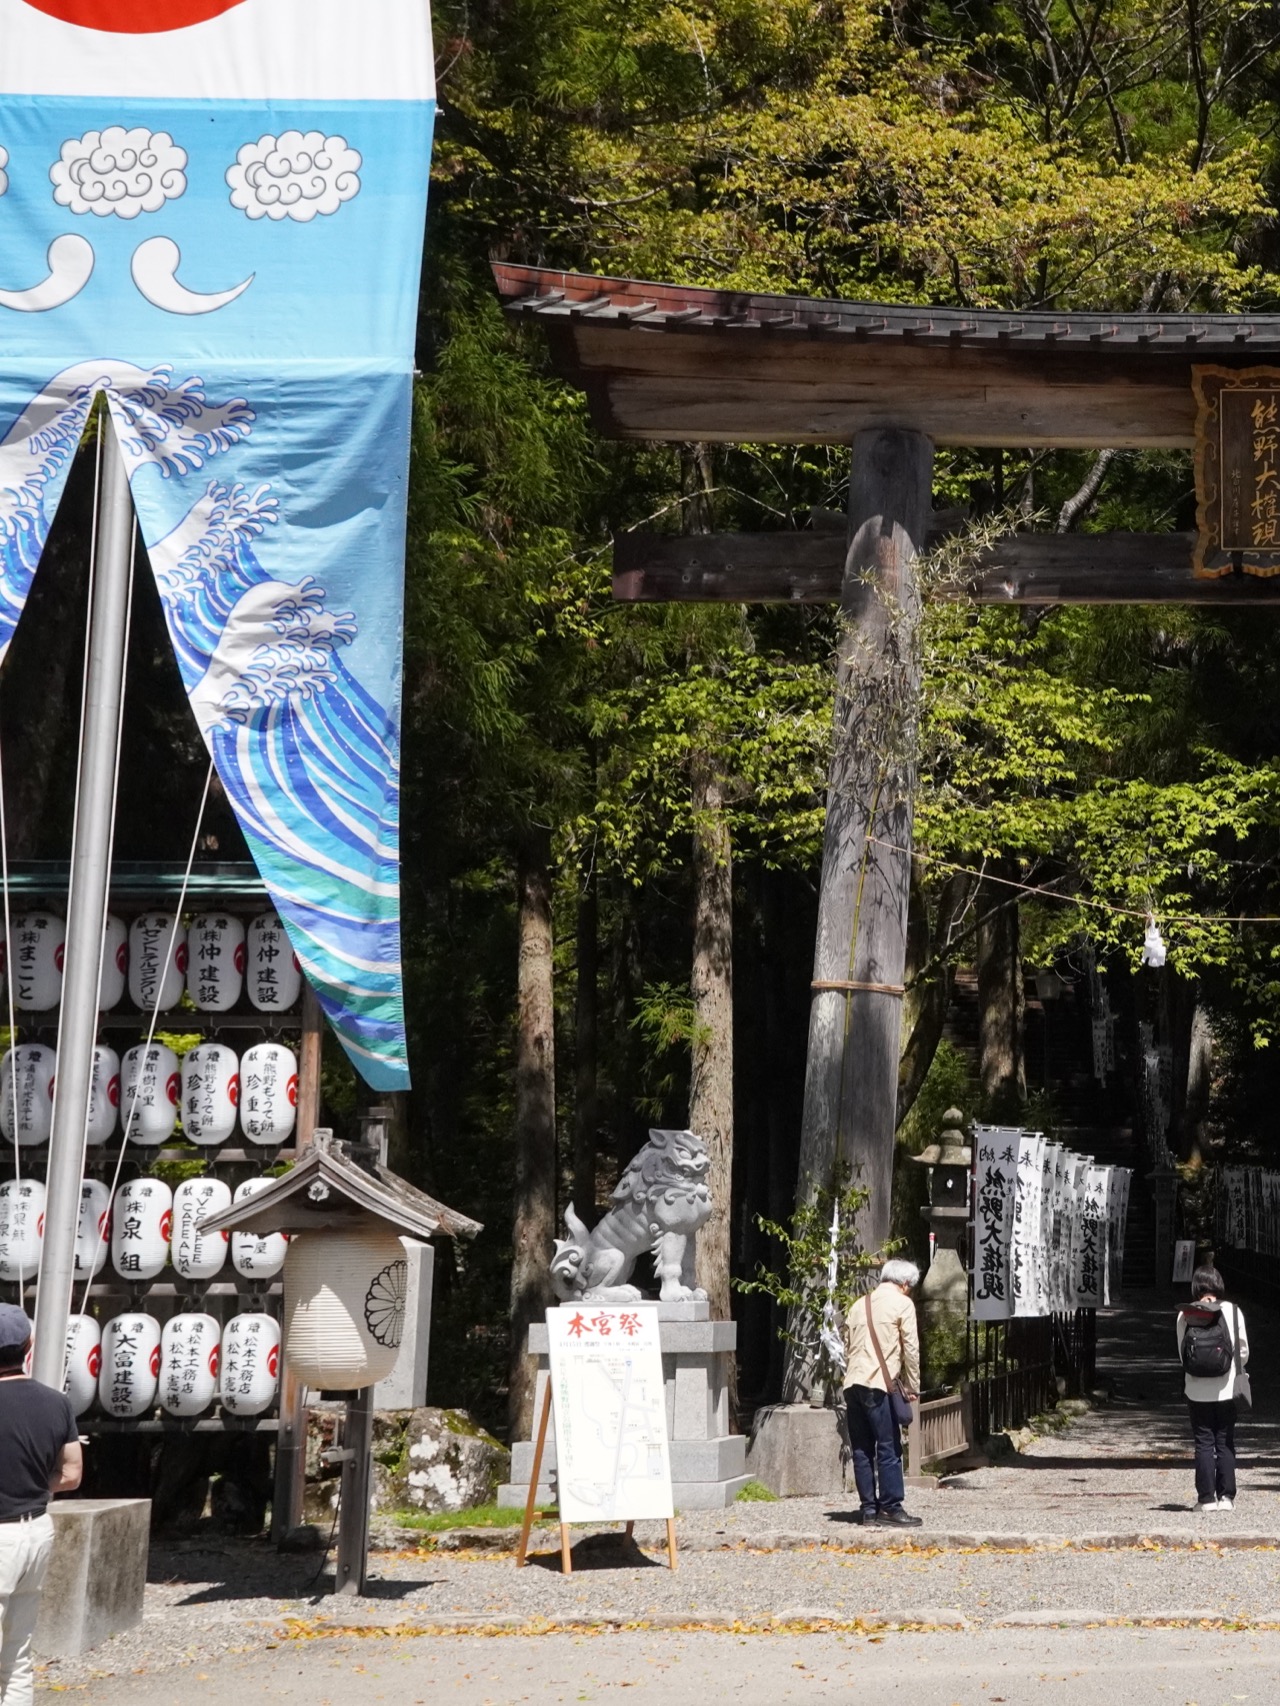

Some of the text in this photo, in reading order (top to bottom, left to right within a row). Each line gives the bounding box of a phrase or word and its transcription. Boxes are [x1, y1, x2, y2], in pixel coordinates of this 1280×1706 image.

[246, 1073, 262, 1136] 珍重庵
[567, 1311, 643, 1339] 本宮祭
[181, 1334, 202, 1395] 松本工務店
[238, 1336, 258, 1395] 松本工務店
